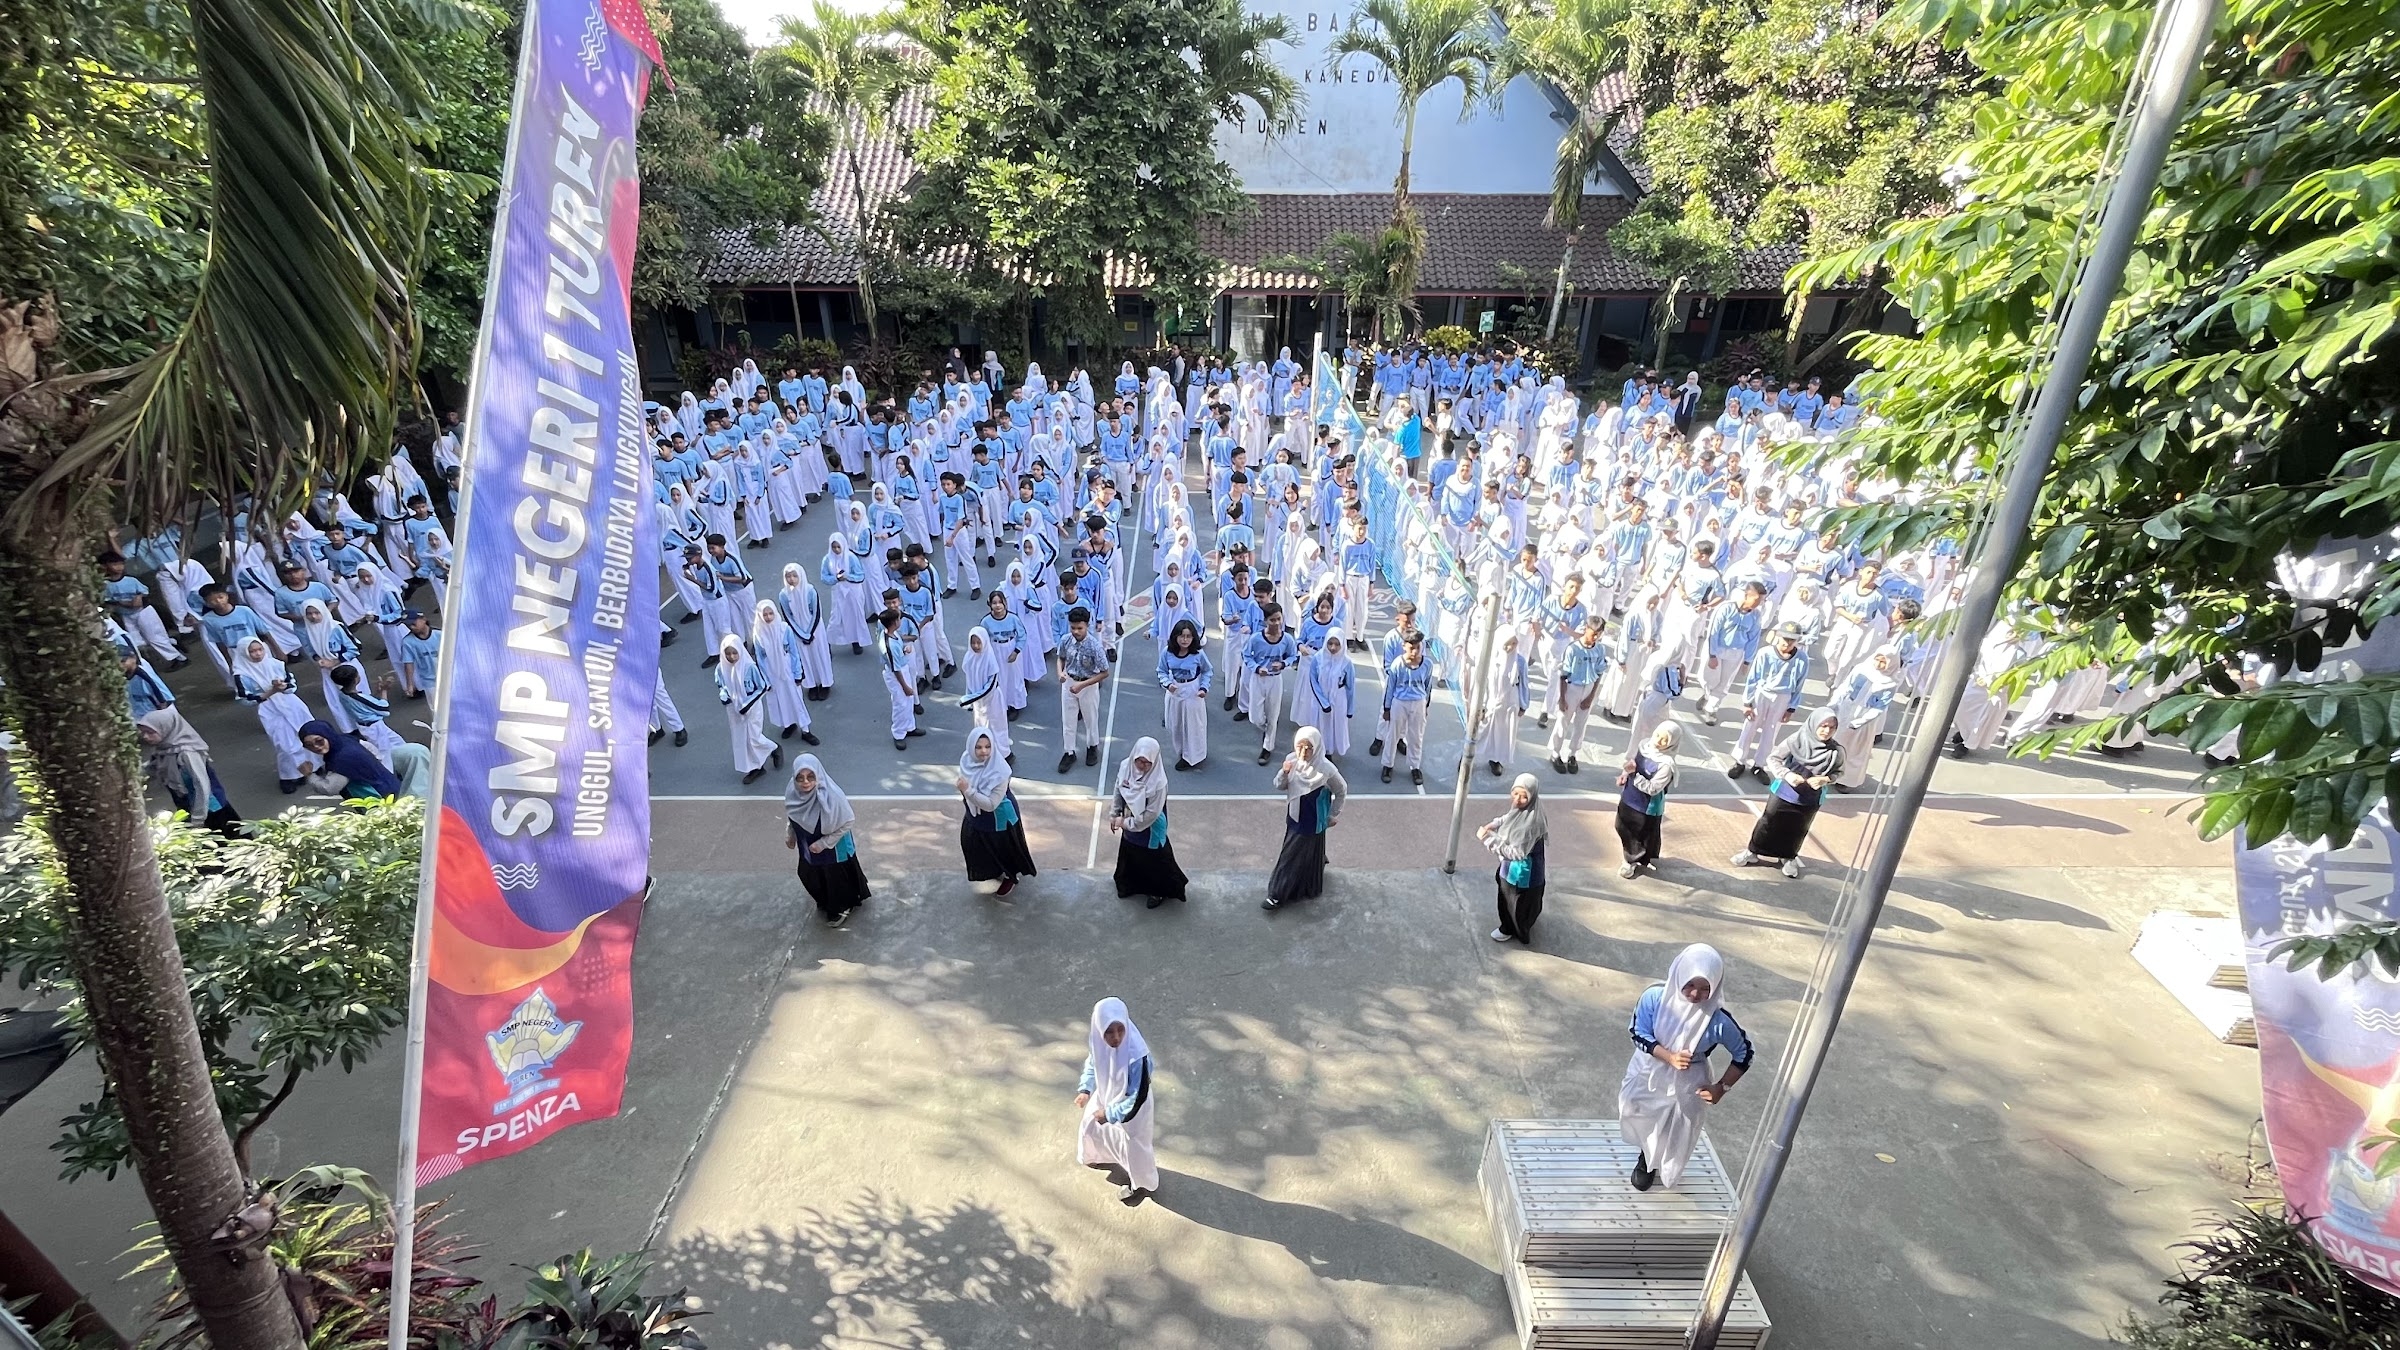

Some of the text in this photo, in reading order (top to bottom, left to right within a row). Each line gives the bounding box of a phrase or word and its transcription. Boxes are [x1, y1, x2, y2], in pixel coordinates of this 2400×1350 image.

[1239, 119, 1327, 135] TUREN
[488, 82, 604, 837] SMP NEGERI 1 TUREN
[572, 348, 641, 837] UNGGUL, SANTUN, BERBUDAYA LINGKUNGAN
[501, 1022, 521, 1037] SMP
[521, 1018, 553, 1028] NEGERI
[512, 1070, 536, 1086] TUREN
[456, 1092, 581, 1155] SPENZA
